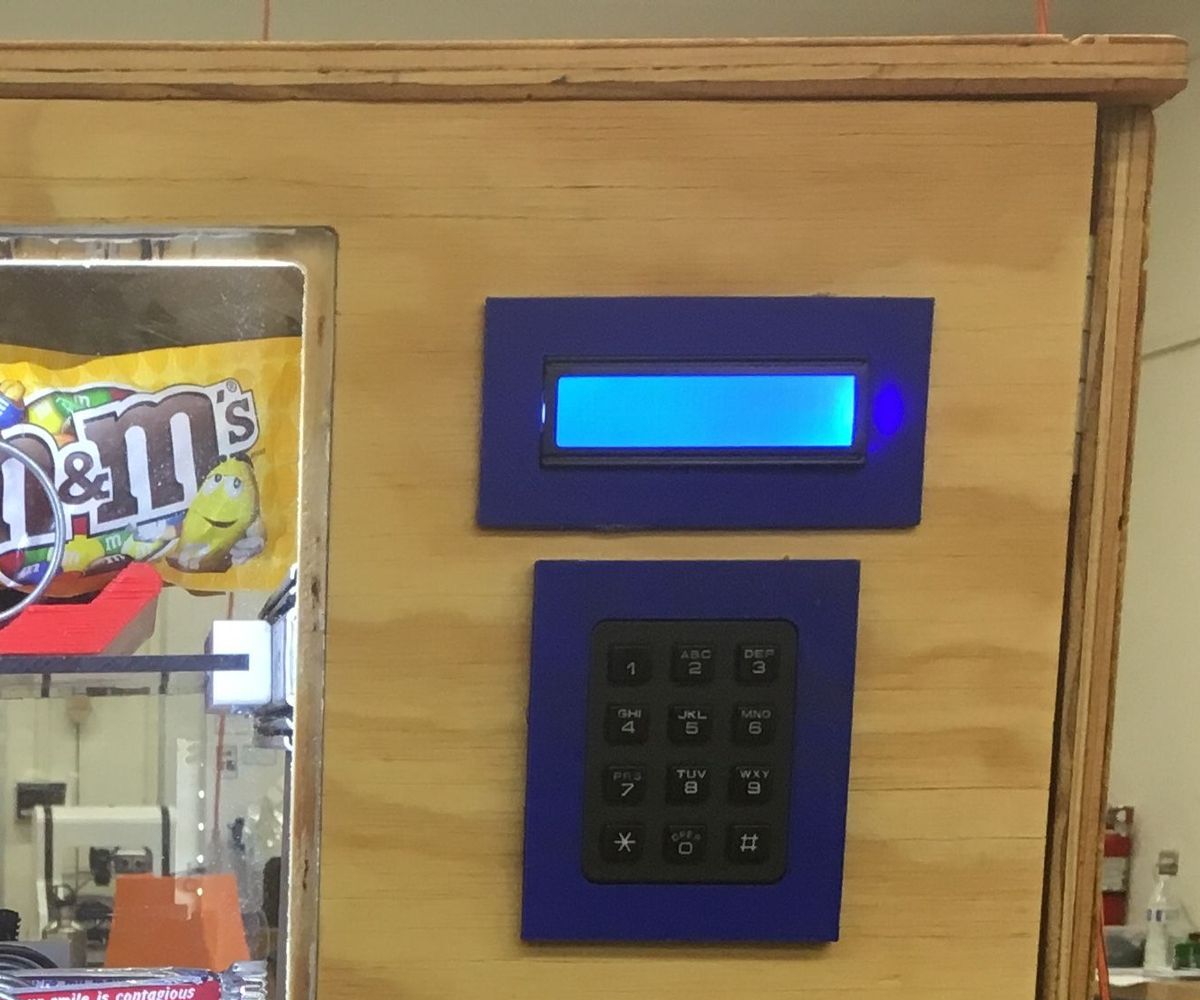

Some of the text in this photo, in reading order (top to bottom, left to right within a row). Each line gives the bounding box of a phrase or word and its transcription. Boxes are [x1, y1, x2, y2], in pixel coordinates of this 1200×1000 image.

[680, 649, 712, 659] ABC
[744, 649, 775, 659] DEF
[626, 662, 636, 676] 1
[688, 661, 702, 675] 2
[752, 661, 766, 674] 3
[617, 708, 642, 719] GHI
[677, 709, 707, 720] JKL
[741, 709, 772, 719] MNO
[621, 721, 636, 734] 4
[685, 722, 698, 734] 5
[748, 721, 762, 735] 6
[676, 769, 707, 779] TUV
[739, 769, 770, 779] WXY
[621, 783, 635, 797] 7
[684, 781, 698, 794] 8
[747, 781, 761, 794] 9
